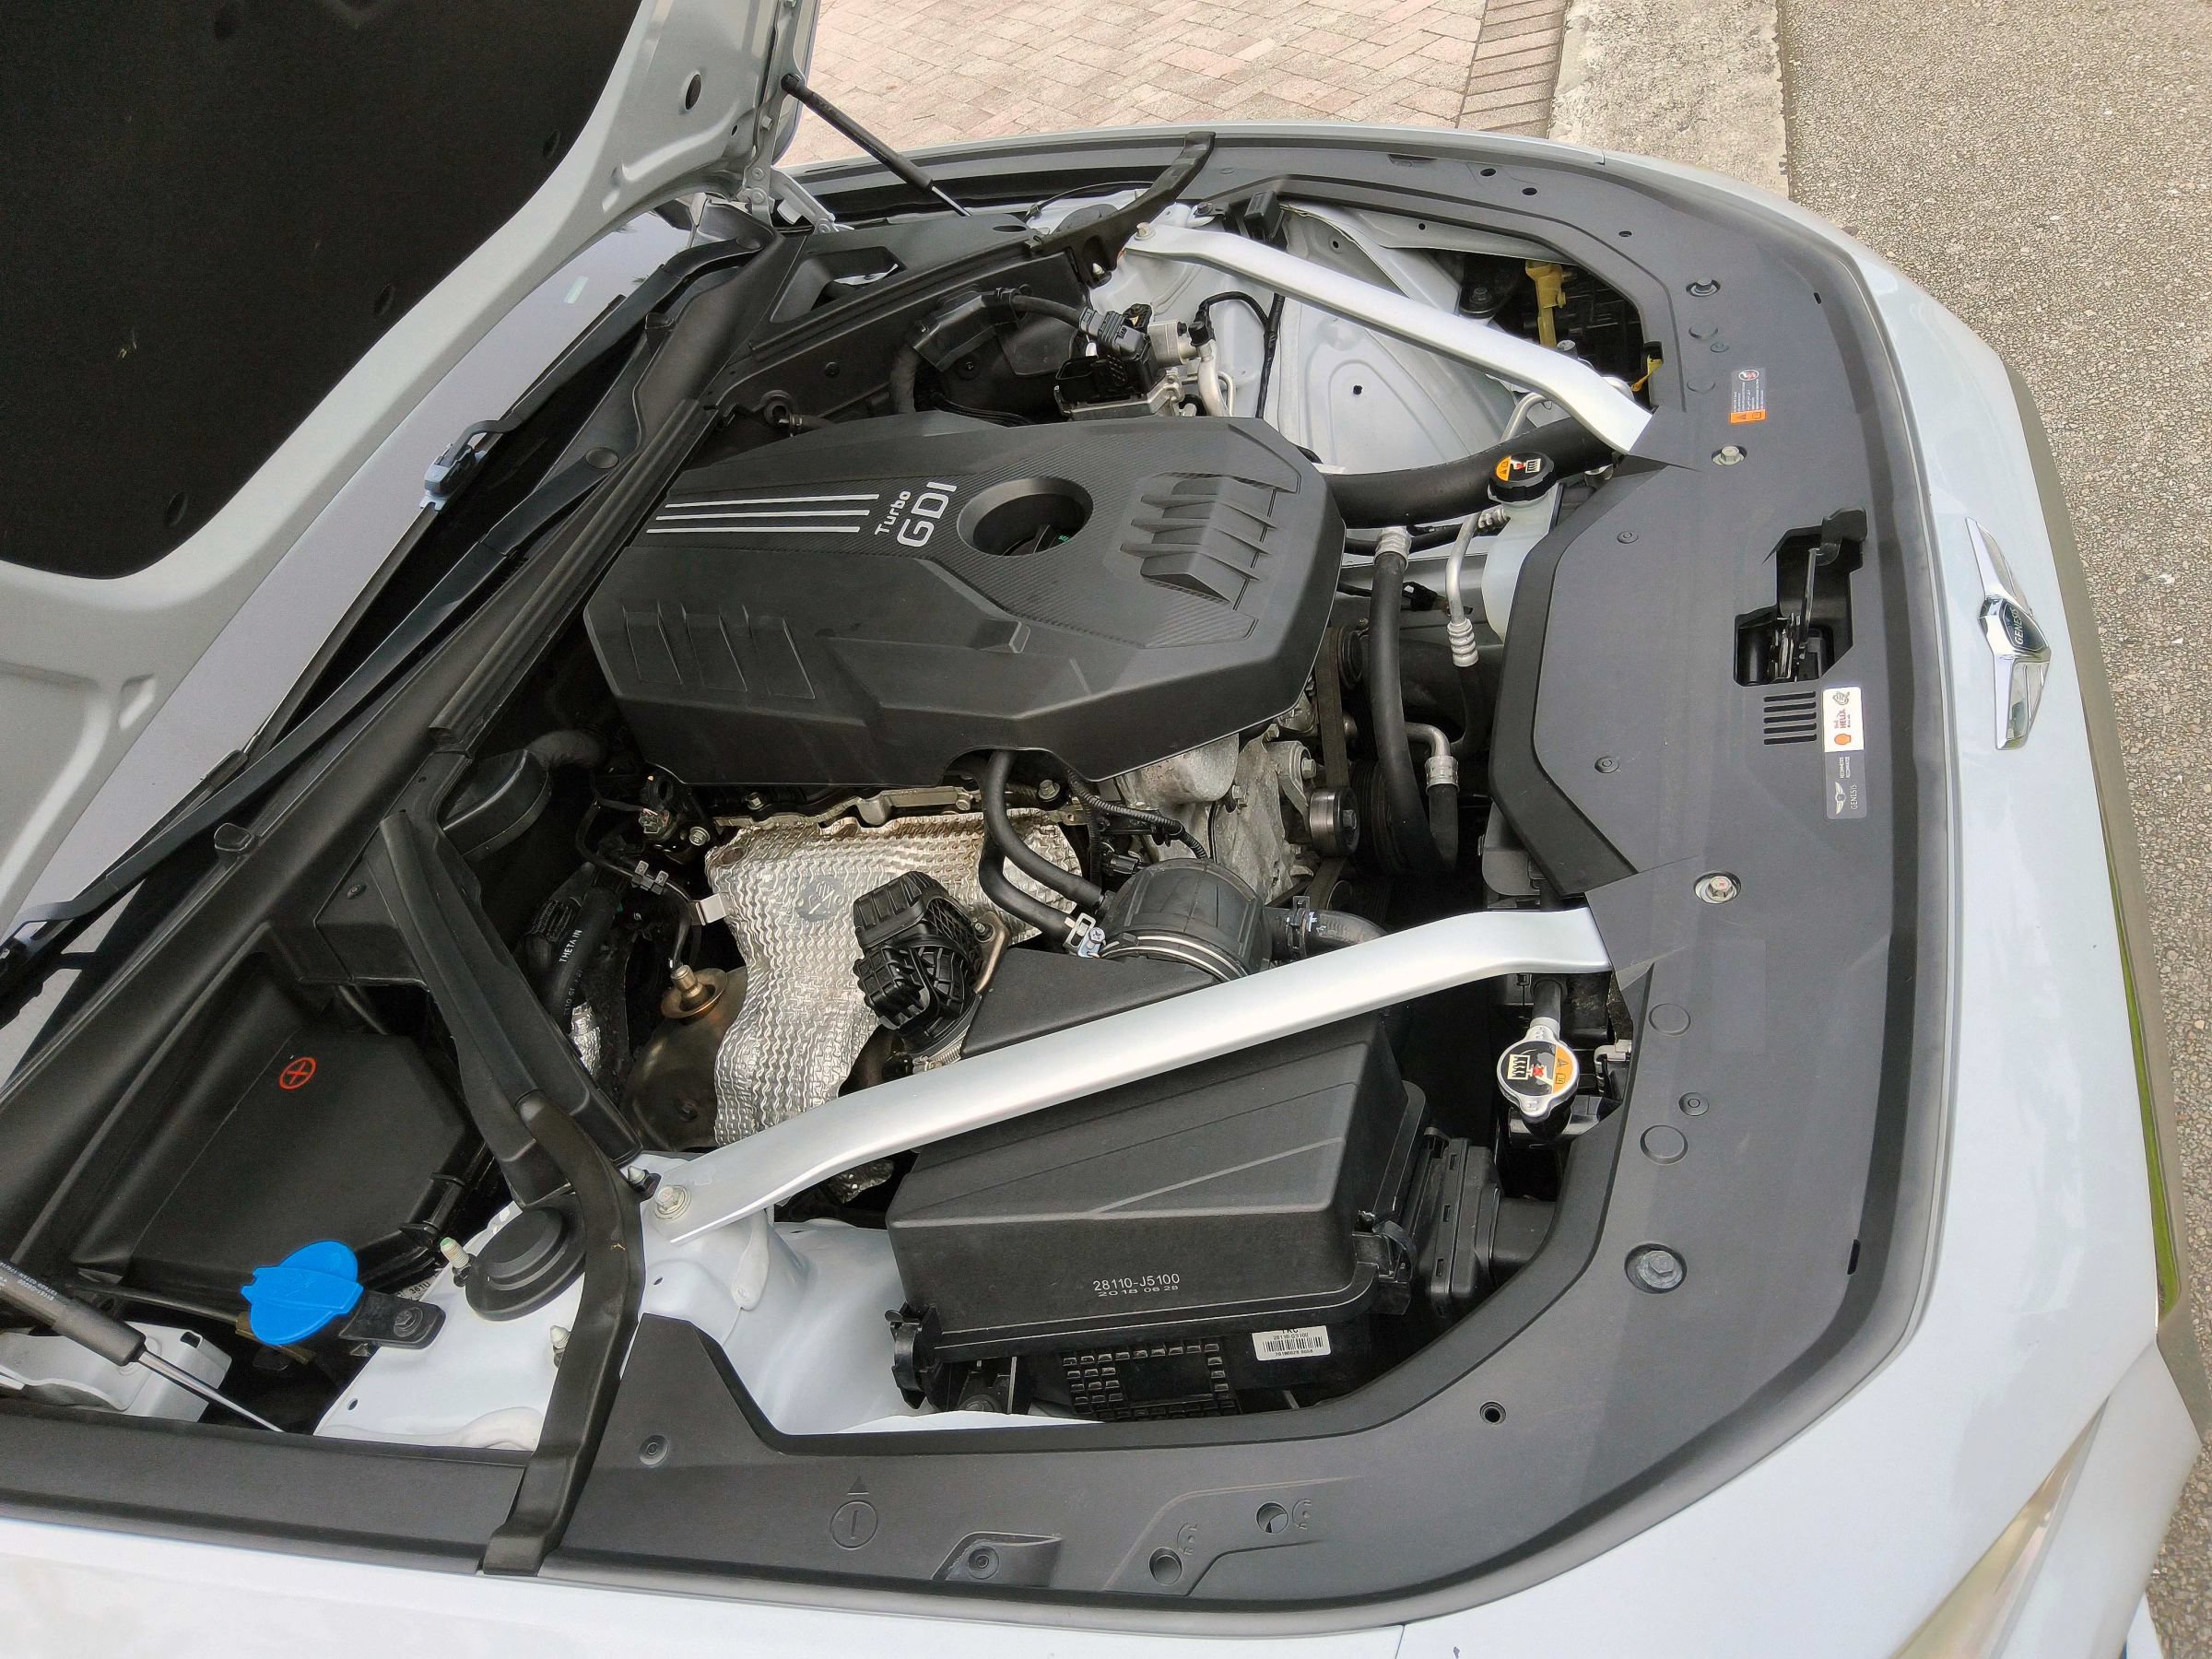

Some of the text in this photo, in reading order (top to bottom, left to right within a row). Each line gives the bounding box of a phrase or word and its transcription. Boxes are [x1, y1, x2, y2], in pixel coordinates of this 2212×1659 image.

[874, 490, 911, 535] Turbo
[897, 481, 957, 547] GDI
[2009, 606, 2024, 644] GENESIS
[1850, 783, 1858, 810] GENESIS
[559, 929, 582, 962] THETA IN
[1092, 1273, 1180, 1291] 28110-J5100
[1098, 1288, 1138, 1298] 2018
